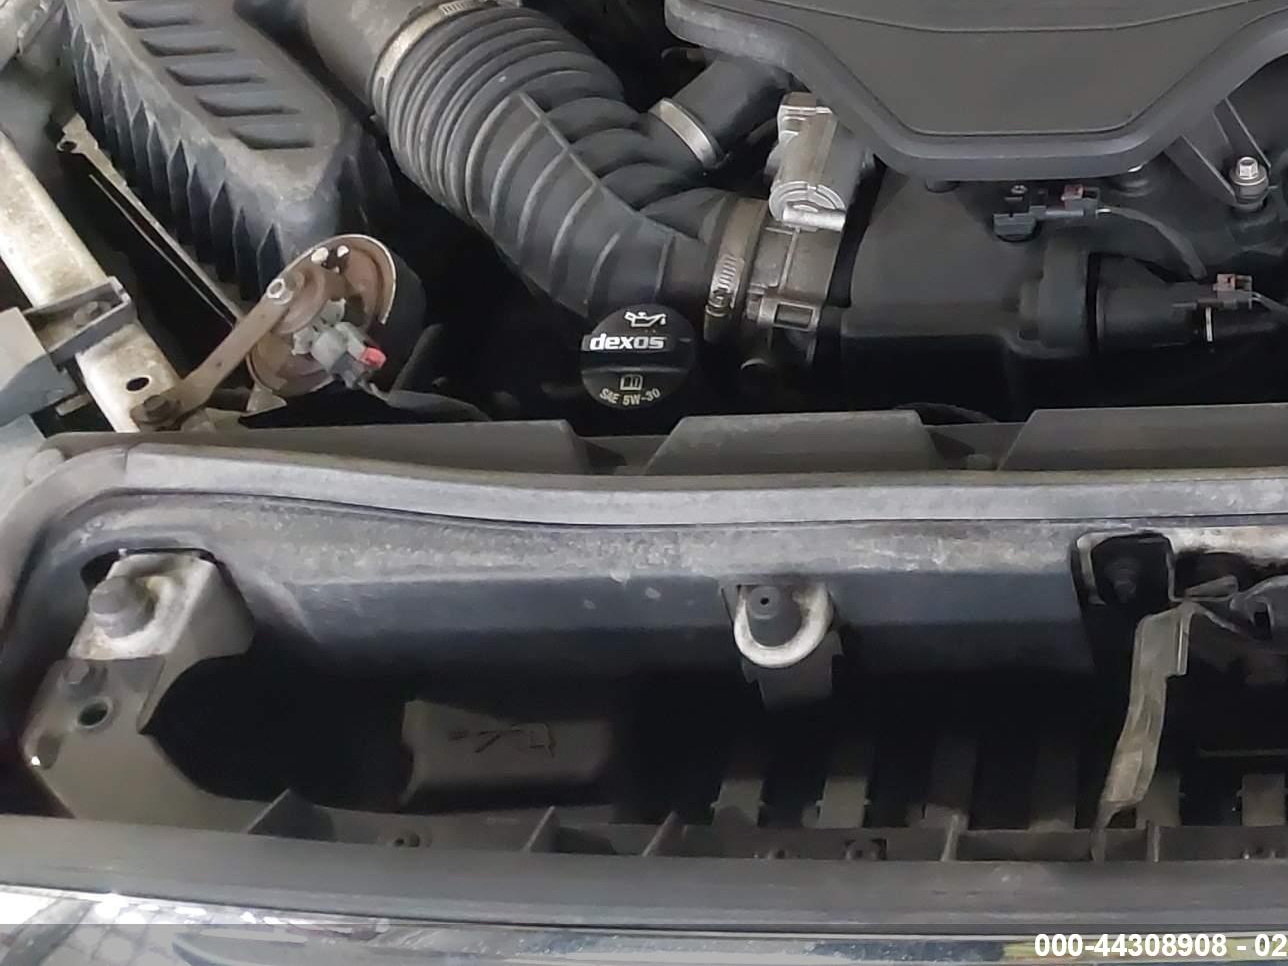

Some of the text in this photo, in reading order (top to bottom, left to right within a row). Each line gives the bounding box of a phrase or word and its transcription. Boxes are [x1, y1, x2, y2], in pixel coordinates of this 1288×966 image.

[590, 333, 666, 350] dexos
[599, 388, 661, 406] SAE 5W-30
